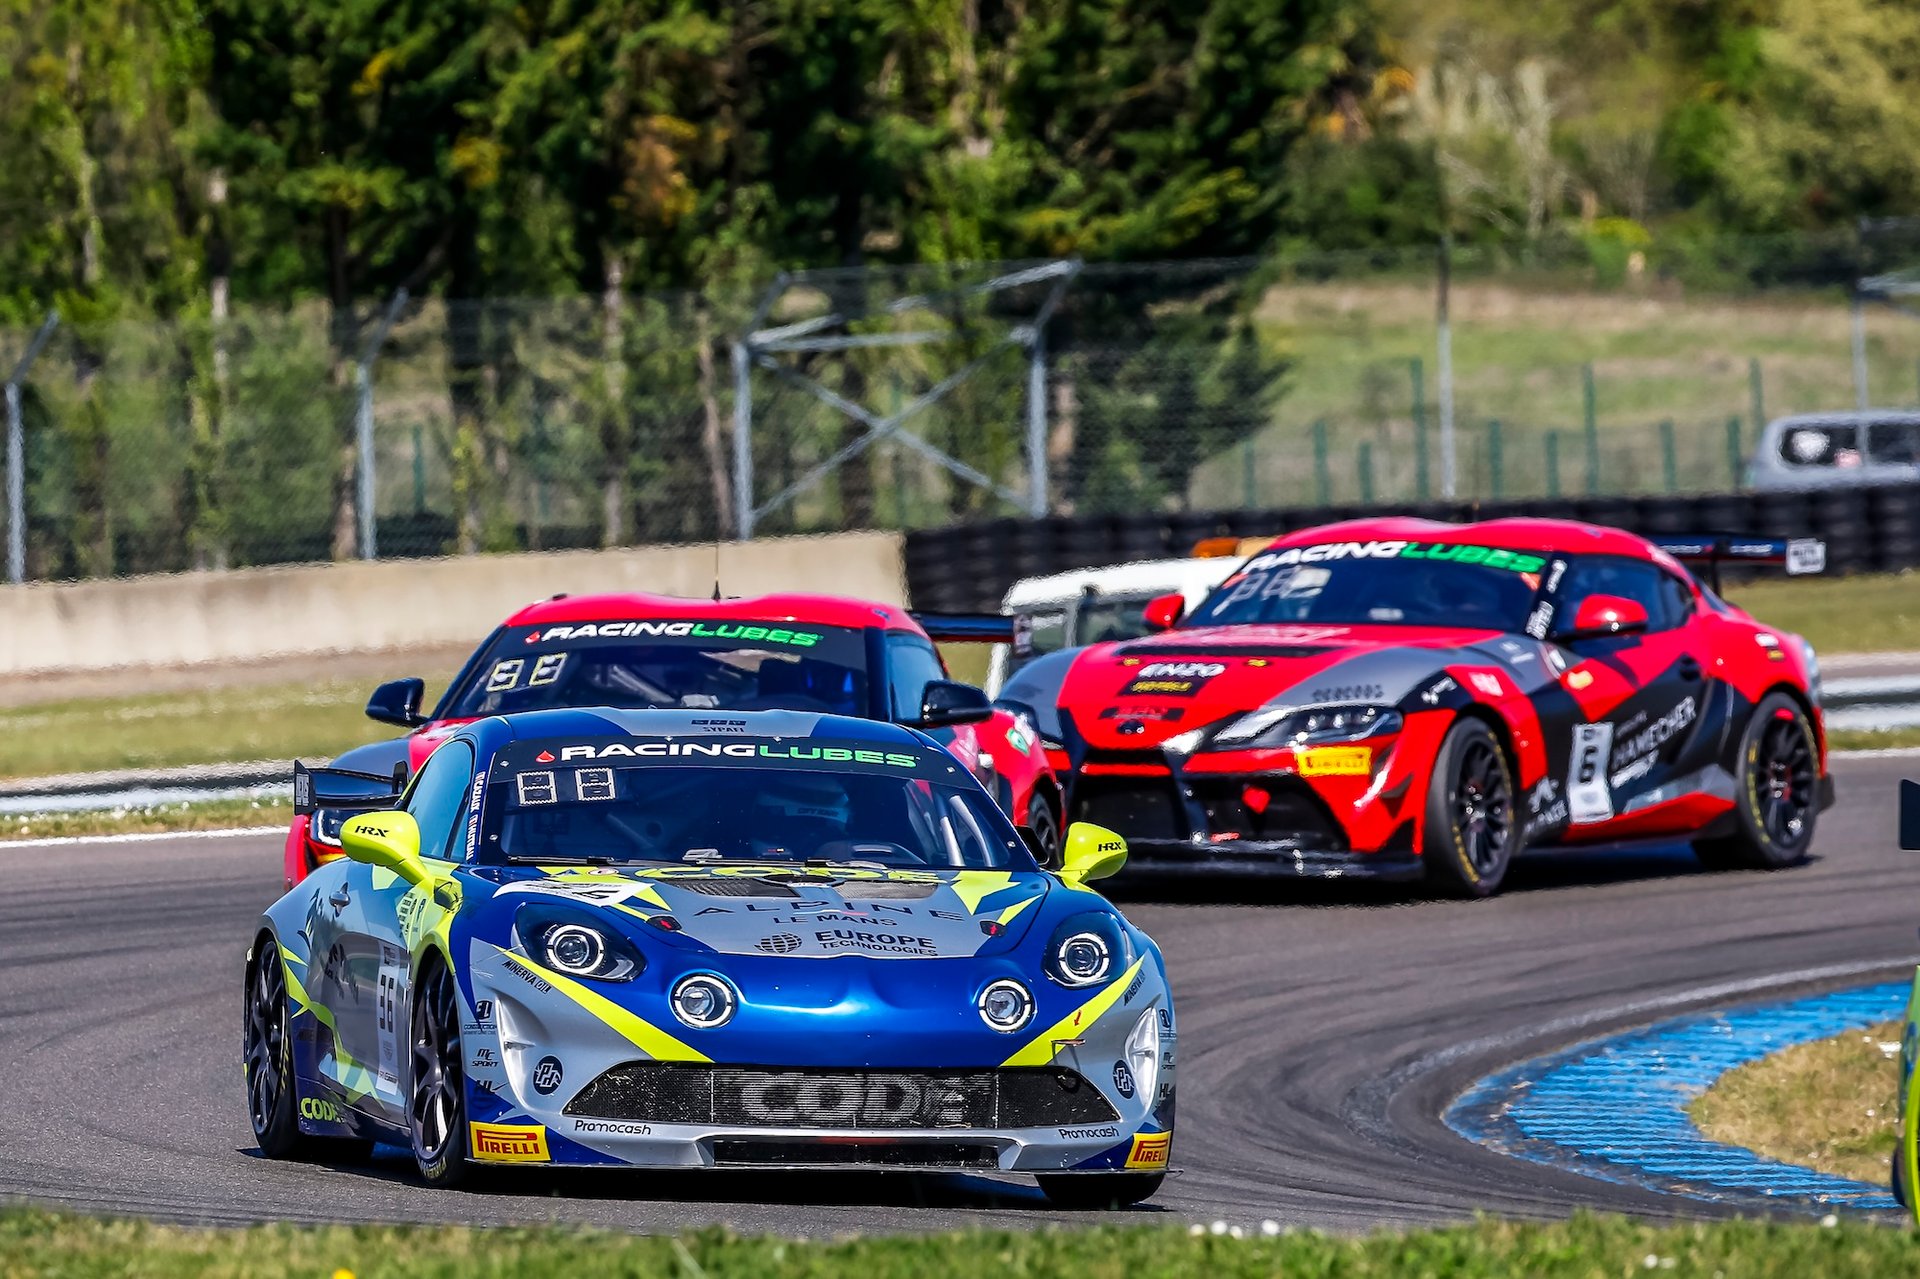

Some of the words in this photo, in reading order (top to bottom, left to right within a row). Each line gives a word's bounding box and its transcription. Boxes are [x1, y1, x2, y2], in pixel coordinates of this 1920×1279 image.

[541, 622, 818, 647] RACINGLUBES
[560, 743, 917, 768] RACINGLUBES
[354, 825, 389, 838] HRX
[1097, 841, 1122, 853] HRX
[693, 901, 965, 922] ALPINE
[773, 917, 808, 925] LE
[816, 915, 898, 926] MANS
[815, 930, 937, 949] EUROPE
[819, 942, 938, 957] TECHNOLOGIES
[501, 959, 538, 986] MINERVA
[534, 981, 552, 994] OIL
[575, 1119, 651, 1136] Promocash
[1058, 1126, 1120, 1139] Promocash
[476, 1129, 540, 1155] PIRELLI
[1132, 1138, 1168, 1162] PIREL
